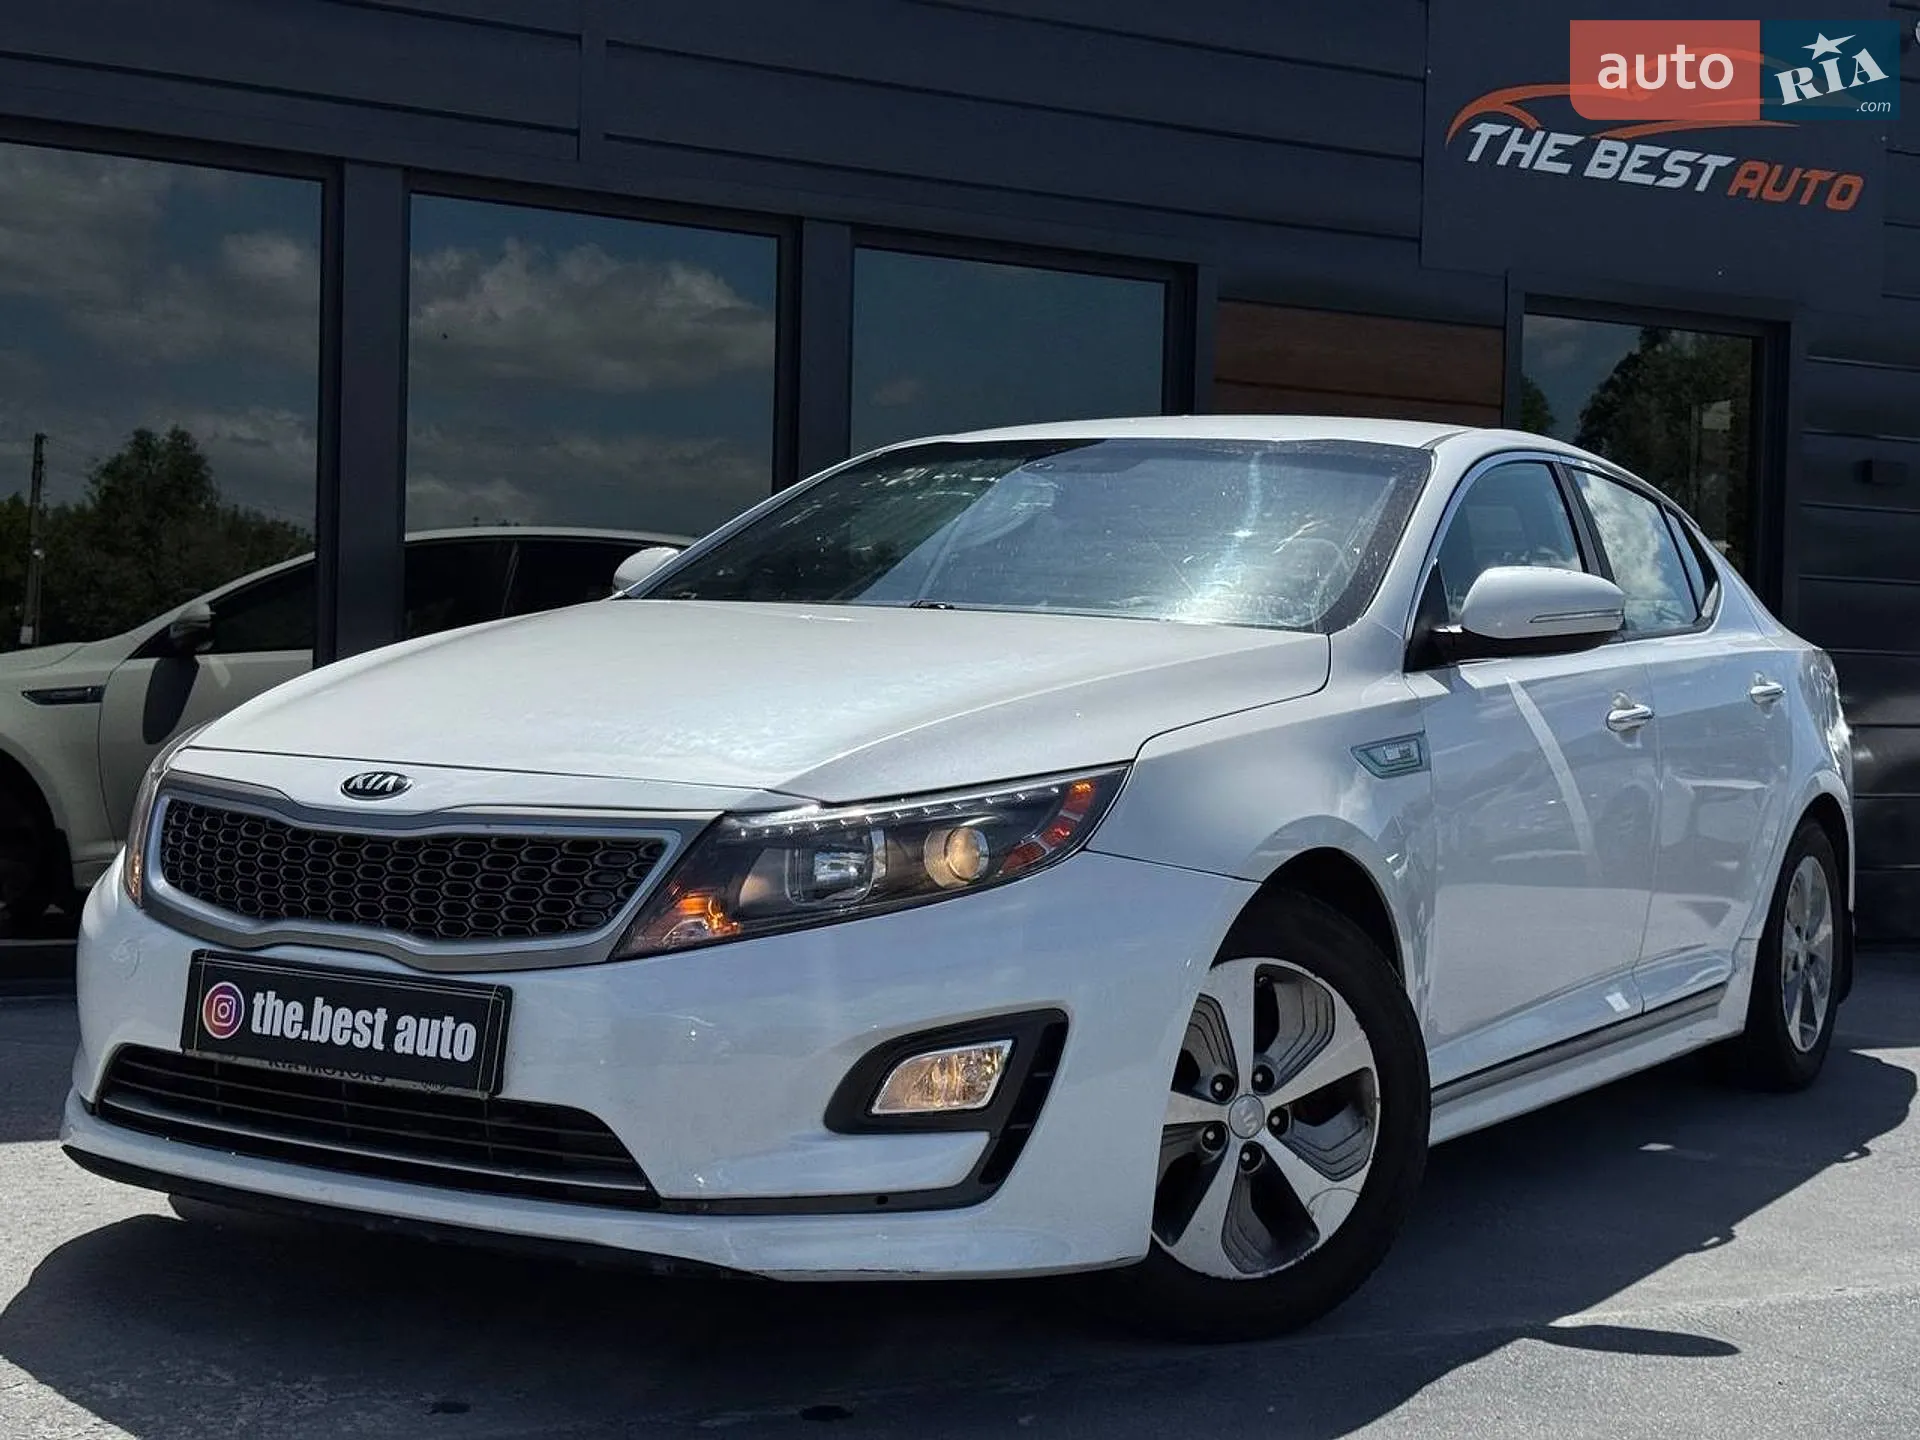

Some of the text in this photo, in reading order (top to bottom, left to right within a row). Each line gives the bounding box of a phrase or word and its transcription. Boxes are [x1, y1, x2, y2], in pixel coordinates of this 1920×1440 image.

[1467, 123, 1865, 211] THE BEST AUTO
[347, 773, 399, 792] KIA
[251, 991, 477, 1062] the.best auto
